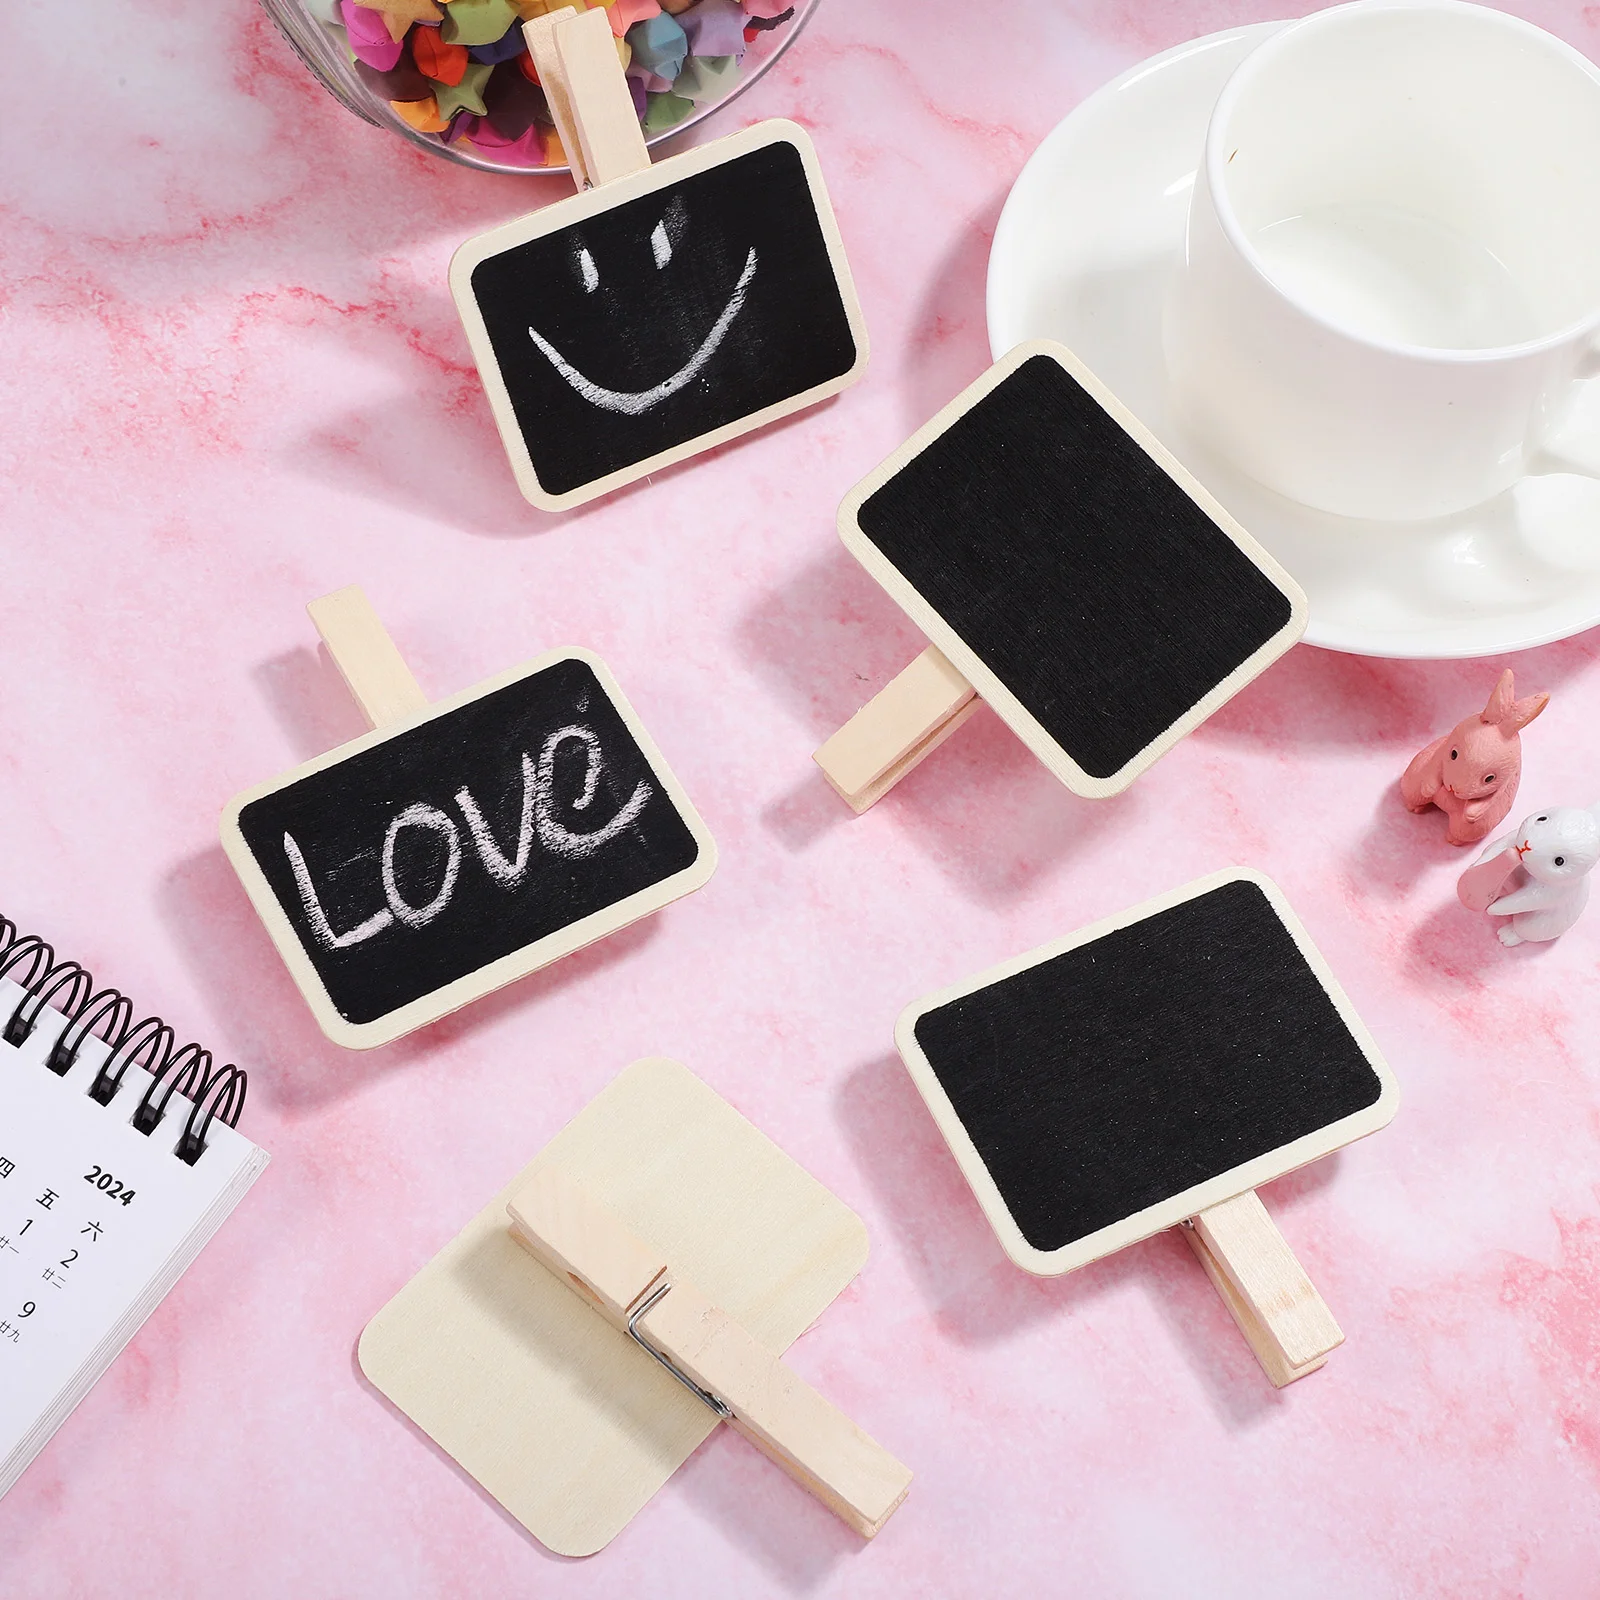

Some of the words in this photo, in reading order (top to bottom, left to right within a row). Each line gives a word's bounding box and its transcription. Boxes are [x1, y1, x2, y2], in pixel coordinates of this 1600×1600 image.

[0, 1156, 16, 1179] 四
[35, 1187, 60, 1210] 五
[80, 1221, 104, 1242] 六
[83, 1165, 136, 1207] 2024
[19, 1219, 34, 1236] 1
[60, 1249, 79, 1269] 2
[41, 1267, 67, 1290] 廿二
[17, 1301, 37, 1318] 9
